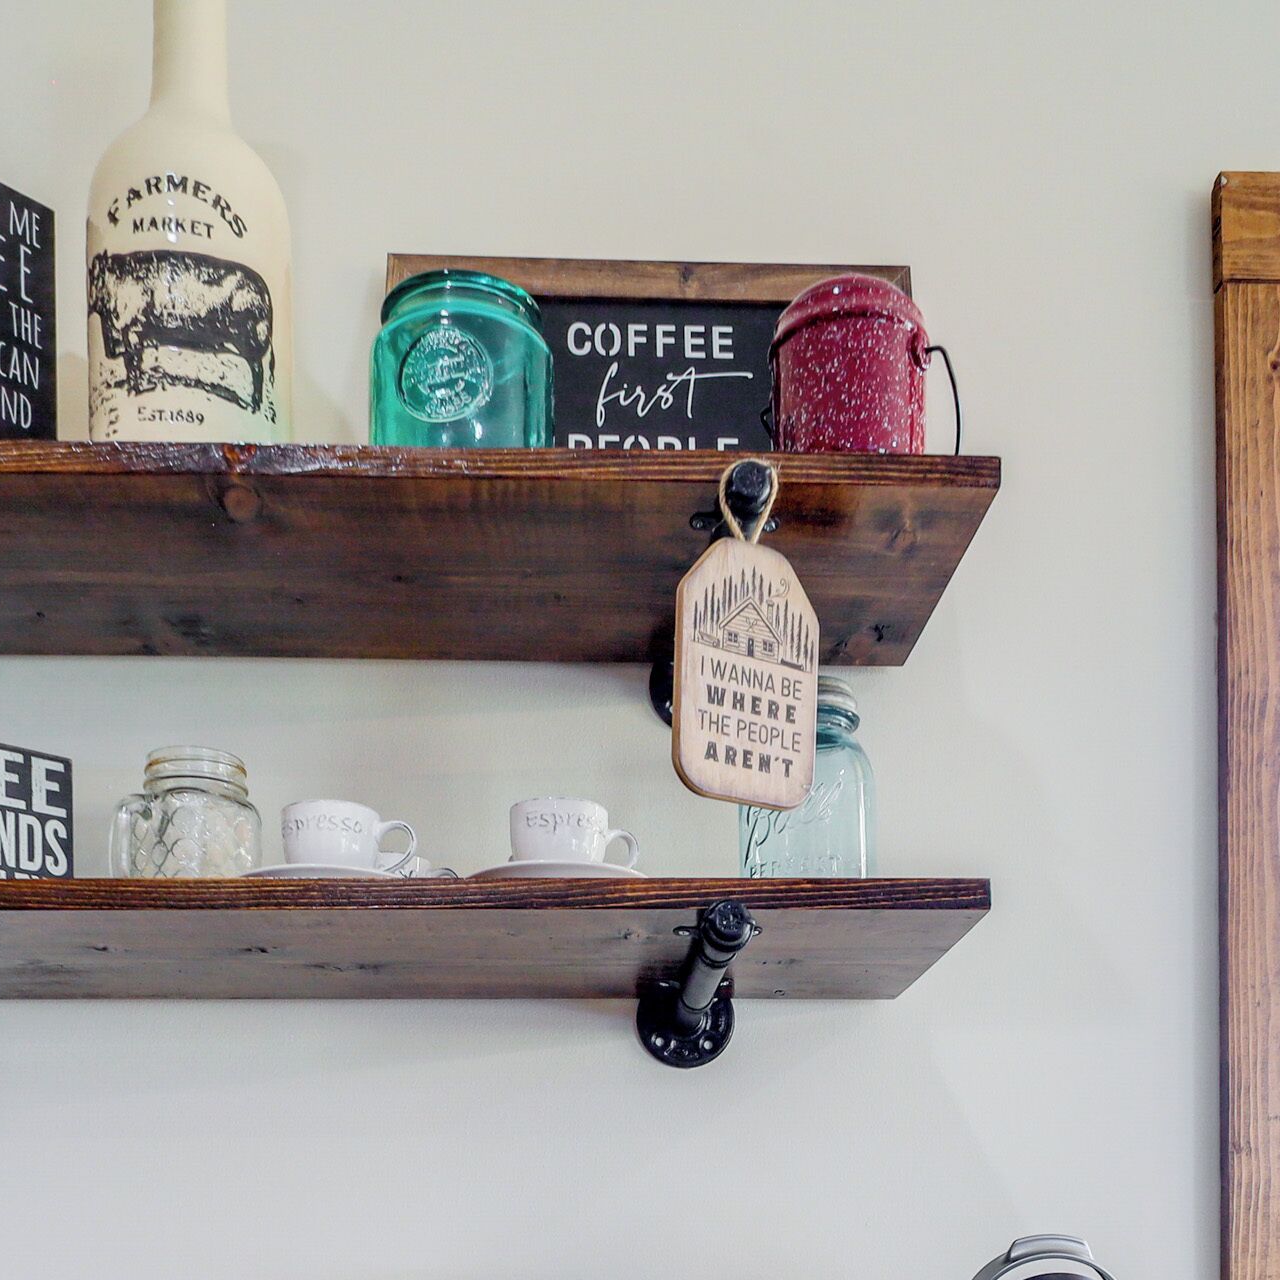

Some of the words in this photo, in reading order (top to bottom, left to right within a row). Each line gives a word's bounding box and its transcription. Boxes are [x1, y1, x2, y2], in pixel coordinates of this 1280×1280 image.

[9, 200, 41, 249] ME
[106, 173, 249, 240] FARMERS
[132, 216, 216, 241] MARKET
[9, 301, 44, 350] THE
[567, 321, 735, 360] COFFEE
[596, 361, 754, 428] first
[710, 657, 776, 695] WANNA
[781, 676, 804, 702] BE
[706, 683, 798, 725] WHERE
[697, 707, 732, 737] THE
[736, 718, 803, 754] PEOPLE
[703, 740, 794, 779] AREN'T
